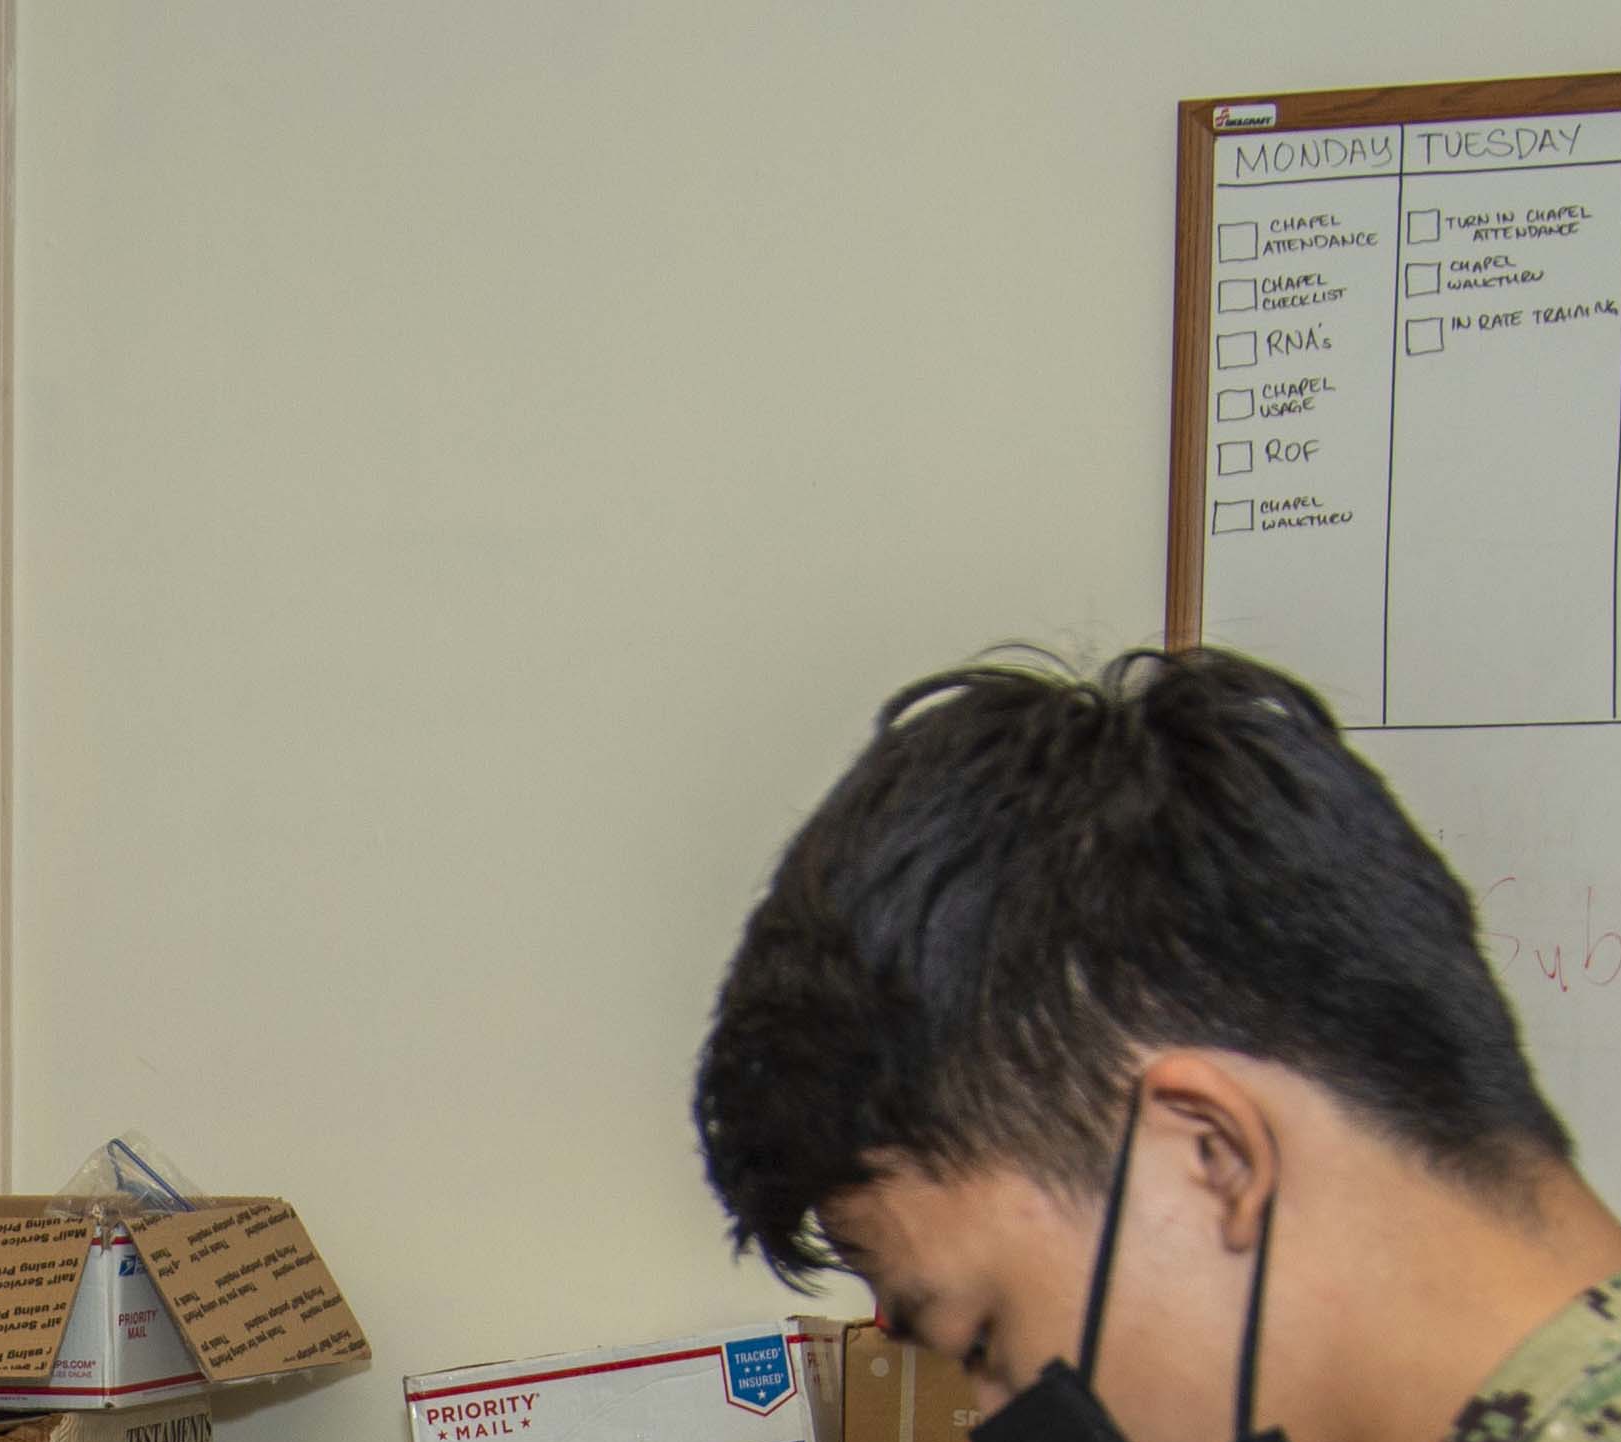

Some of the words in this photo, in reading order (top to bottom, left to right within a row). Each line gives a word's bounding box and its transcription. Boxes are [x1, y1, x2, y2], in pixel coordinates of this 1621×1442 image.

[1420, 124, 1582, 165] TUESDAY
[1235, 136, 1394, 178] MONDAY
[1269, 214, 1342, 234] CHAPEL
[1446, 213, 1490, 232] TURN
[1495, 211, 1515, 225] IN
[1526, 205, 1593, 223] CHAPEL
[1472, 223, 1580, 241] ATTENDANCE
[1262, 232, 1379, 256] ATTENDANCE
[1450, 255, 1516, 273] CHAPEL
[1261, 273, 1328, 294] CHAPEL
[1448, 270, 1545, 290] WALKTHRU
[1262, 288, 1347, 311] CHECKLIST
[1452, 316, 1472, 330] IN
[1478, 311, 1521, 331] RATE
[1533, 300, 1619, 325] TRAINING
[1262, 378, 1336, 400] CHAPEL
[1260, 397, 1315, 418] USAGE
[1265, 440, 1319, 463] ROF
[1261, 496, 1323, 514] CHAPEL
[1262, 512, 1353, 530] WALKTHRU
[118, 1309, 157, 1327] PRIORITY
[128, 1327, 147, 1340] MAIL
[734, 1349, 781, 1364] TRACKED
[738, 1374, 784, 1389] INSURED
[426, 1394, 536, 1426] PRIORITY
[455, 1422, 514, 1441] MAIL
